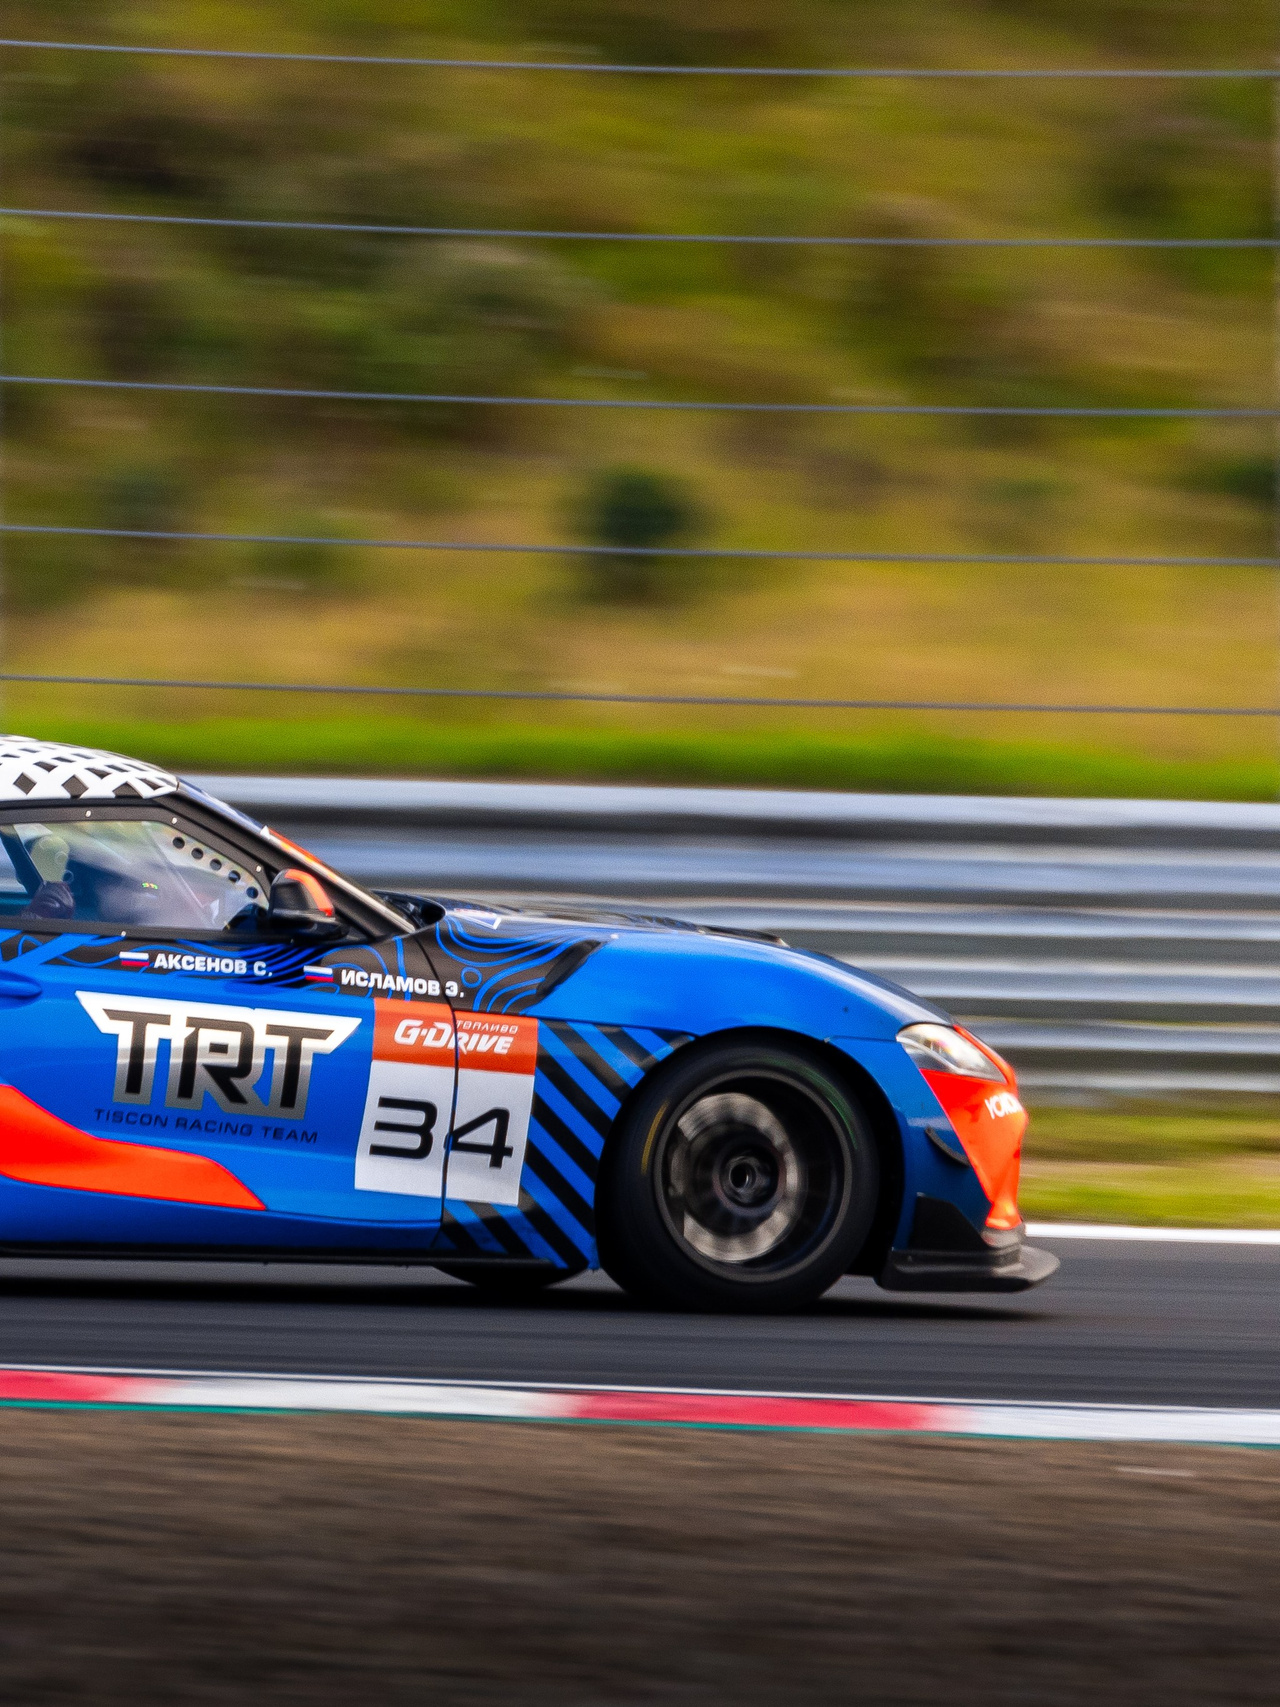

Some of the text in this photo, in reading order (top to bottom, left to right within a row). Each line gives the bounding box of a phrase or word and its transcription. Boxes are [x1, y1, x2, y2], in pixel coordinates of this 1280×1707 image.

[153, 953, 247, 974] АКСЕНОВ
[341, 969, 440, 996] ИСЛАМОВ
[456, 1020, 519, 1034] ТОПЛИВО
[96, 1002, 343, 1112] TRT
[94, 1108, 318, 1144] TISCON RACING TEAM
[369, 1096, 514, 1169] 34
